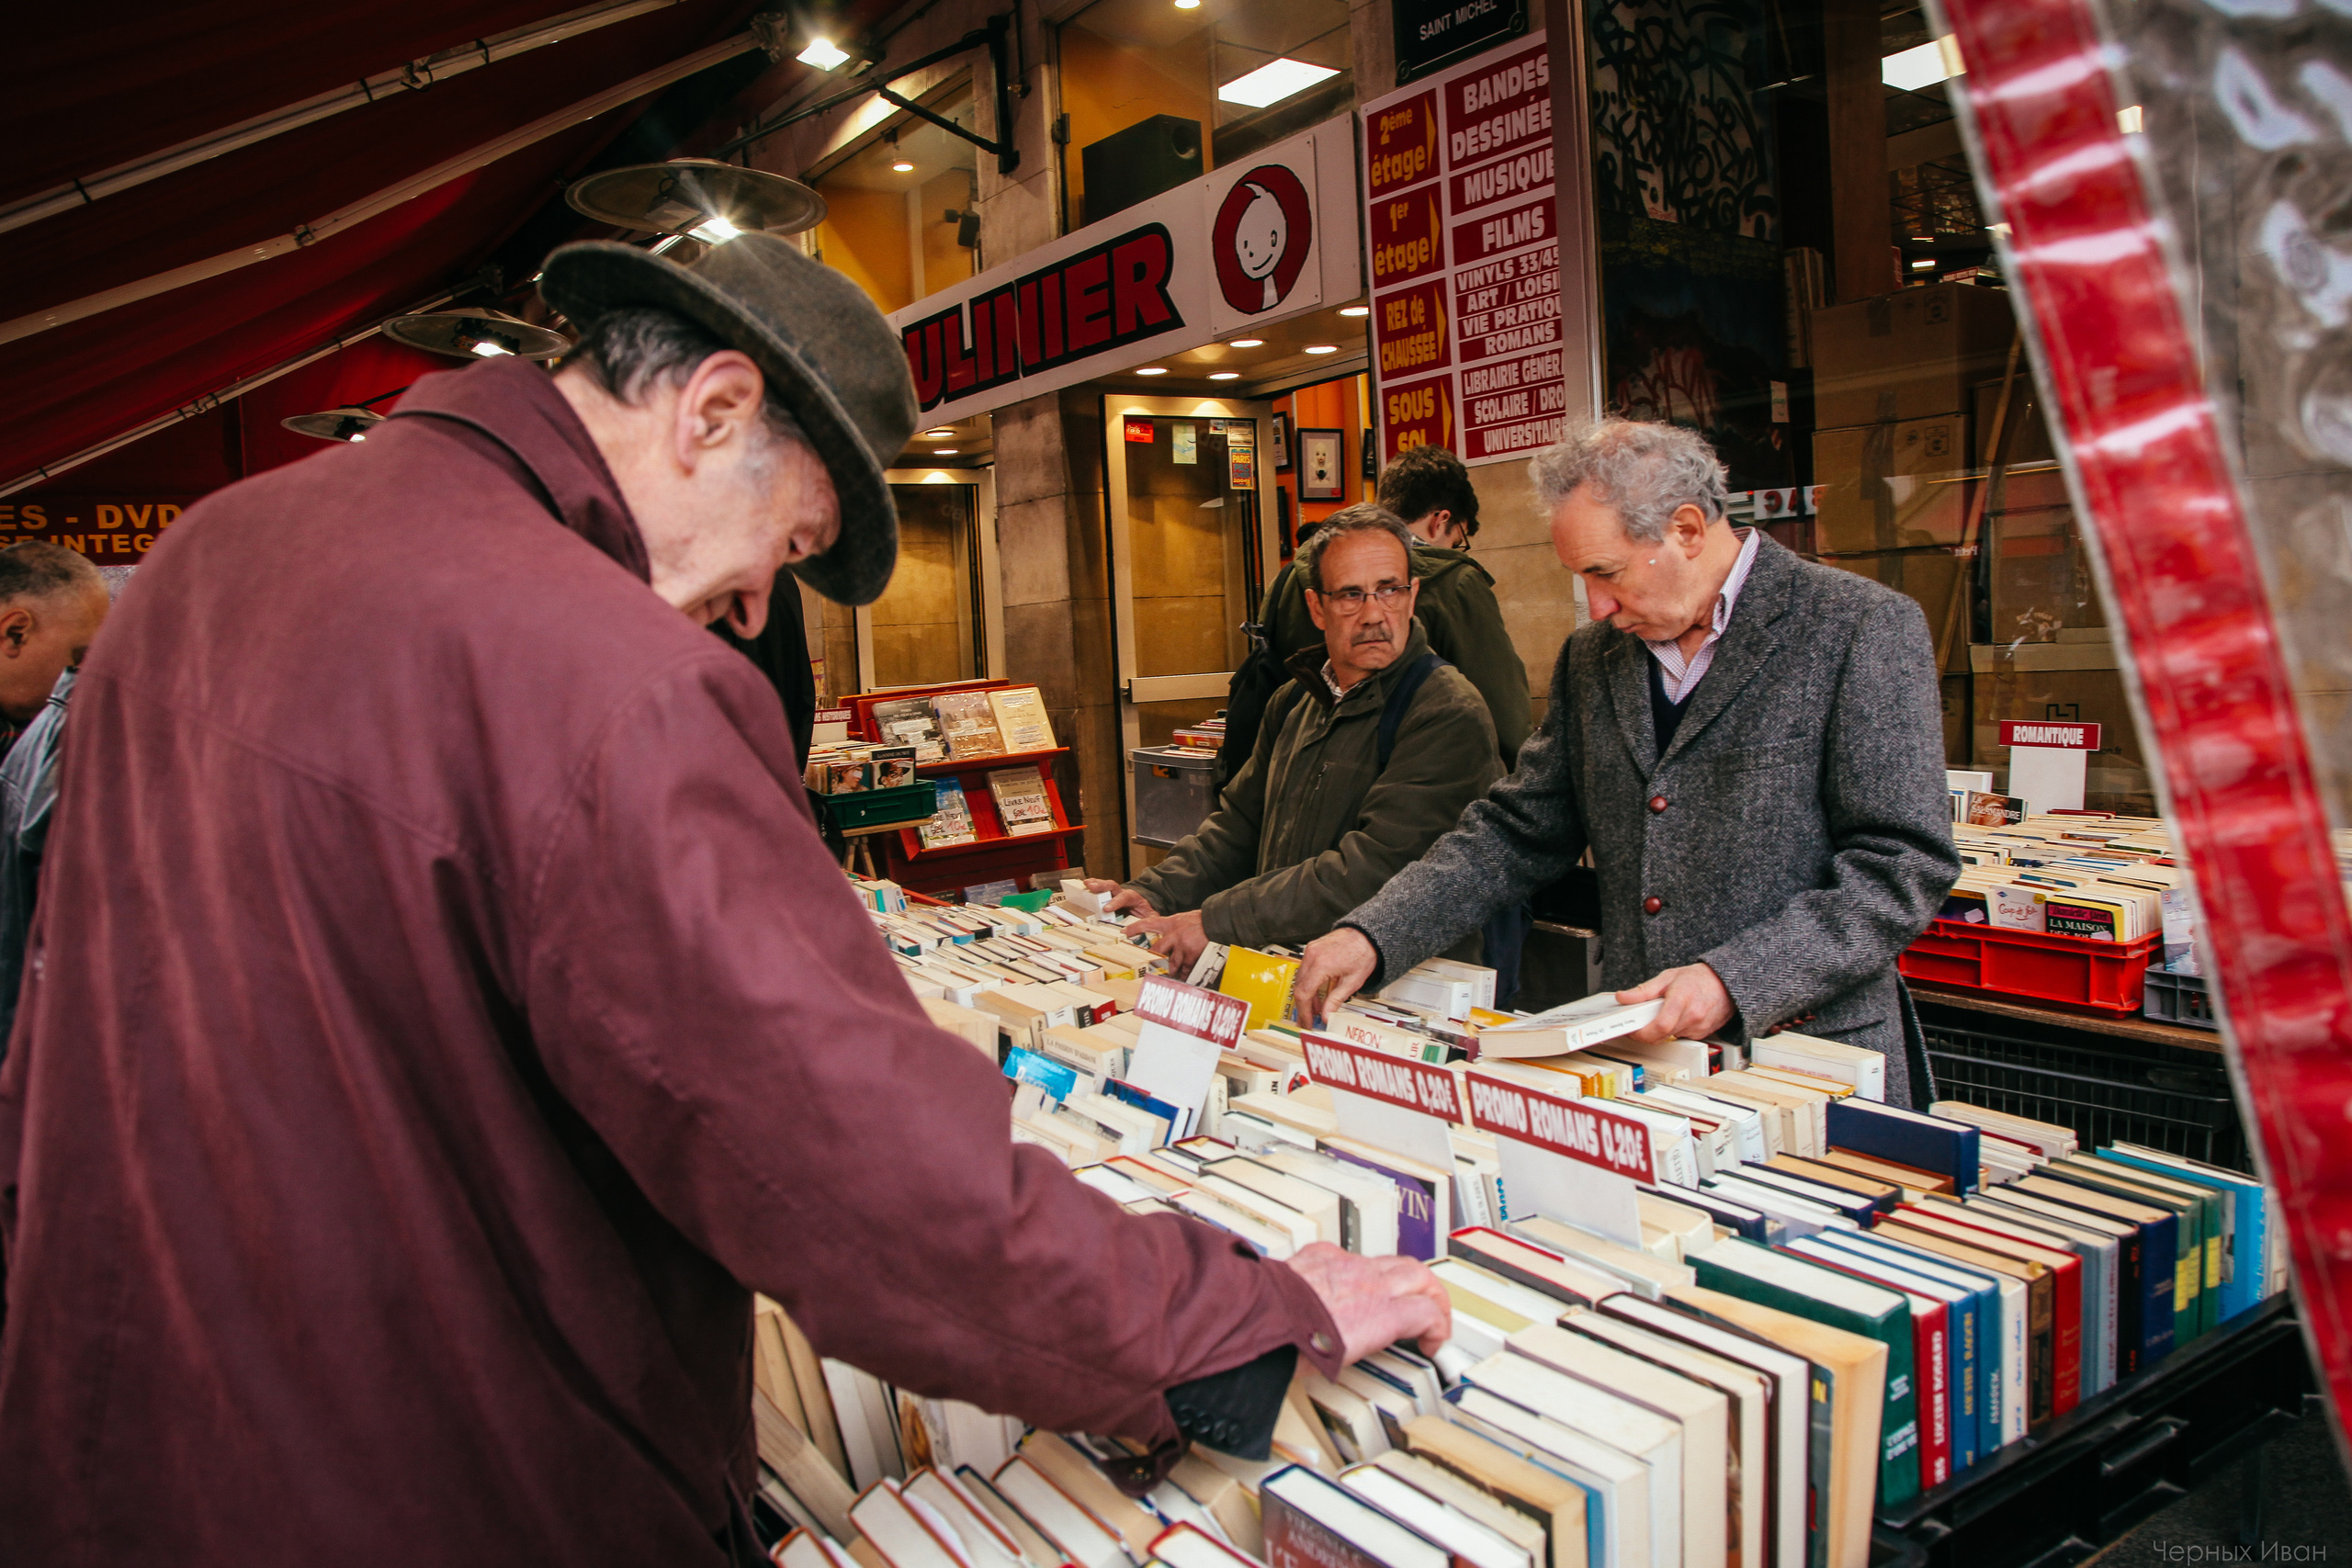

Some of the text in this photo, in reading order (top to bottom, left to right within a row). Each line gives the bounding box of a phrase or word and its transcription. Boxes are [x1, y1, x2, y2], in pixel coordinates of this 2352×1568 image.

[1419, 0, 1498, 41] SAINT MICHEL
[1464, 53, 1549, 115] BANDES
[1380, 107, 1413, 145] 2ème
[1452, 96, 1552, 162] DESSINÉE
[1371, 144, 1425, 186] étage
[1464, 147, 1555, 205] MUSIQUE
[1390, 201, 1409, 231] 1er
[1482, 206, 1544, 253] FILMS
[1374, 237, 1430, 276] étage
[1457, 259, 1514, 291] VINYLS
[902, 224, 1185, 412] ULINIER
[1385, 295, 1425, 331] REZ de
[1466, 288, 1498, 312] ART
[1463, 316, 1489, 337] VIE
[1485, 321, 1555, 355] ROMANS
[1464, 364, 1520, 395] LIBRAIRIE
[1388, 388, 1435, 425] SOUS
[1475, 390, 1529, 424] SCOLAIRE
[2013, 726, 2084, 746] ROMANTIQUE
[1972, 806, 2021, 820] SALAMANDRE
[2050, 919, 2108, 932] LA MAISON
[1137, 981, 1242, 1041] PROMO ROMANS 0,20€
[1306, 1042, 1457, 1115] PROMO ROMANS 0,20€
[1470, 1079, 1528, 1134] PROMO
[1527, 1096, 1600, 1157] ROMANS
[1600, 1118, 1647, 1173] 0,20€
